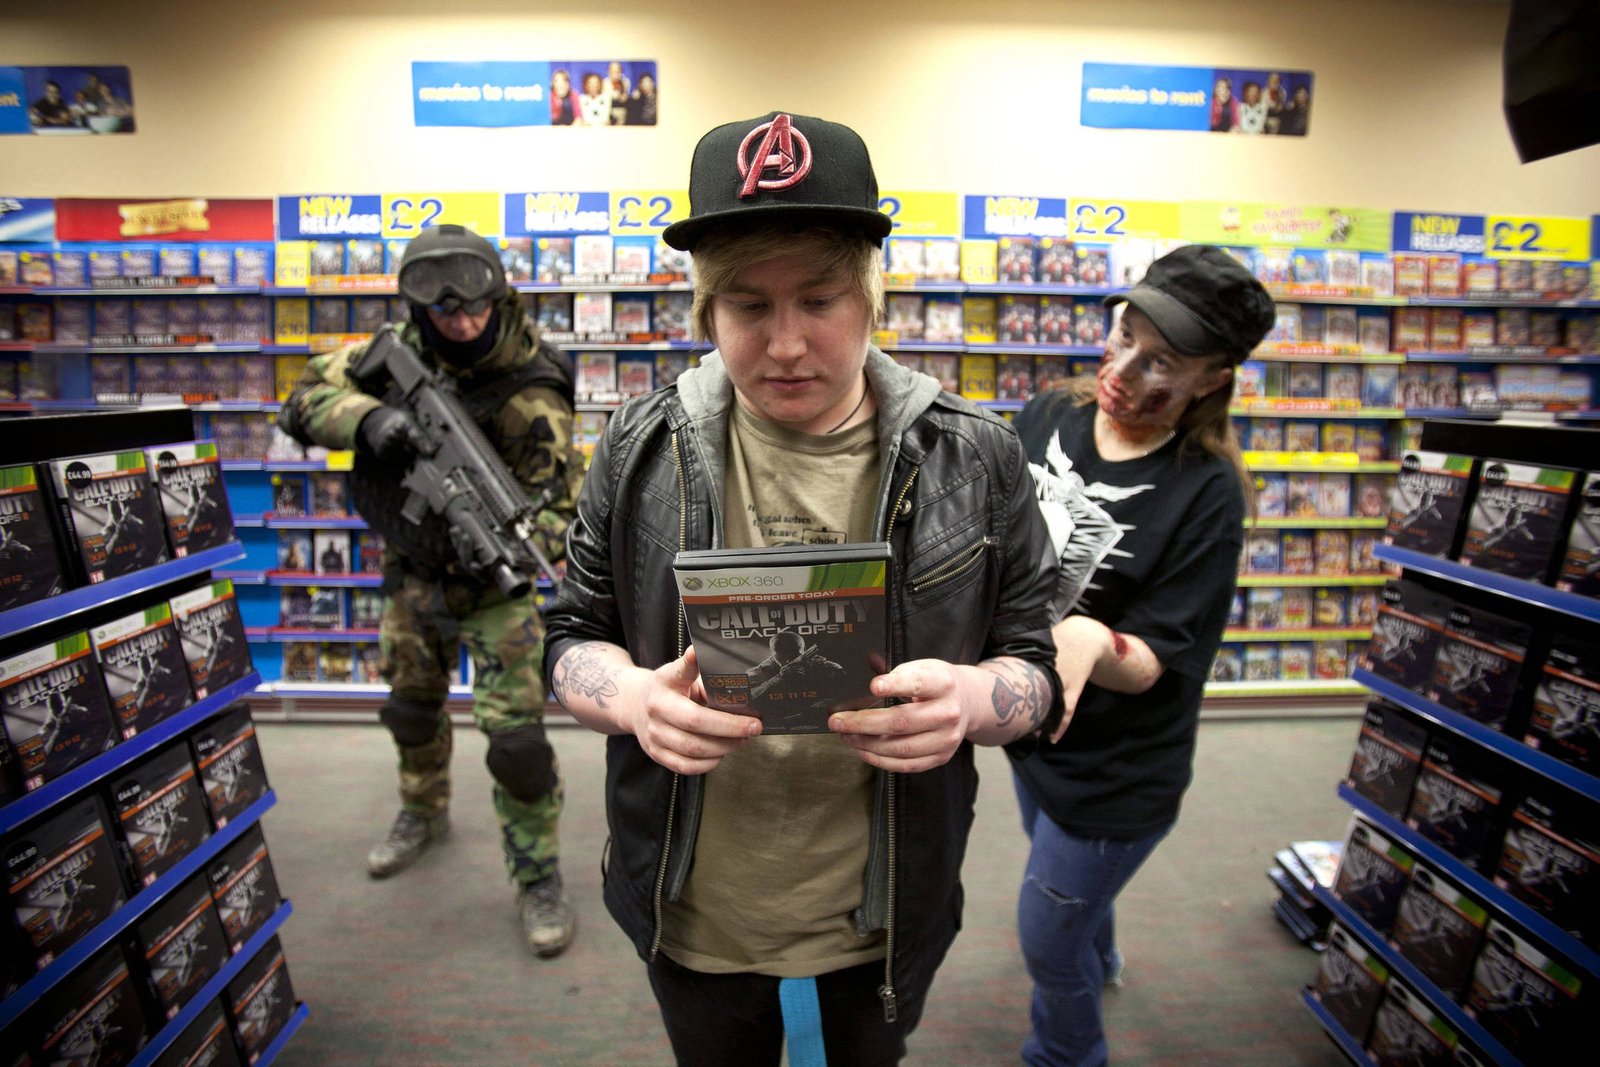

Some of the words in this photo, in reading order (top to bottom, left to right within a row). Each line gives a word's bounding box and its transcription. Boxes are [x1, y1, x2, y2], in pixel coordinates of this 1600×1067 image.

[419, 83, 481, 101] movies
[482, 83, 502, 101] to
[504, 83, 542, 101] rent
[1087, 86, 1148, 105] movies
[1149, 87, 1169, 106] to
[1170, 89, 1205, 107] rent
[299, 195, 352, 216] NEW
[526, 193, 580, 214] NEW
[618, 197, 673, 227] £2
[985, 196, 1039, 218] NEW
[300, 214, 381, 234] RELEASES
[390, 199, 443, 230] £2
[1075, 204, 1127, 234] £2
[1411, 214, 1461, 235] NEW
[1410, 233, 1484, 253] RELEASES
[1492, 222, 1542, 252] £2
[66, 470, 91, 480] £44.99
[768, 528, 798, 538] leave
[809, 535, 839, 545] school
[707, 576, 751, 589] XBOX
[753, 576, 784, 587] 360
[728, 593, 796, 603] PRE-ORDER
[798, 590, 838, 599] TODAY
[697, 605, 771, 631] CALL
[770, 610, 784, 620] OF
[783, 599, 868, 627] DUTY
[721, 627, 792, 640] BLACK
[798, 624, 840, 636] OPS
[768, 692, 784, 701] 13
[788, 691, 799, 699] 11
[803, 691, 817, 699] 12
[8, 847, 37, 867] £44.99
